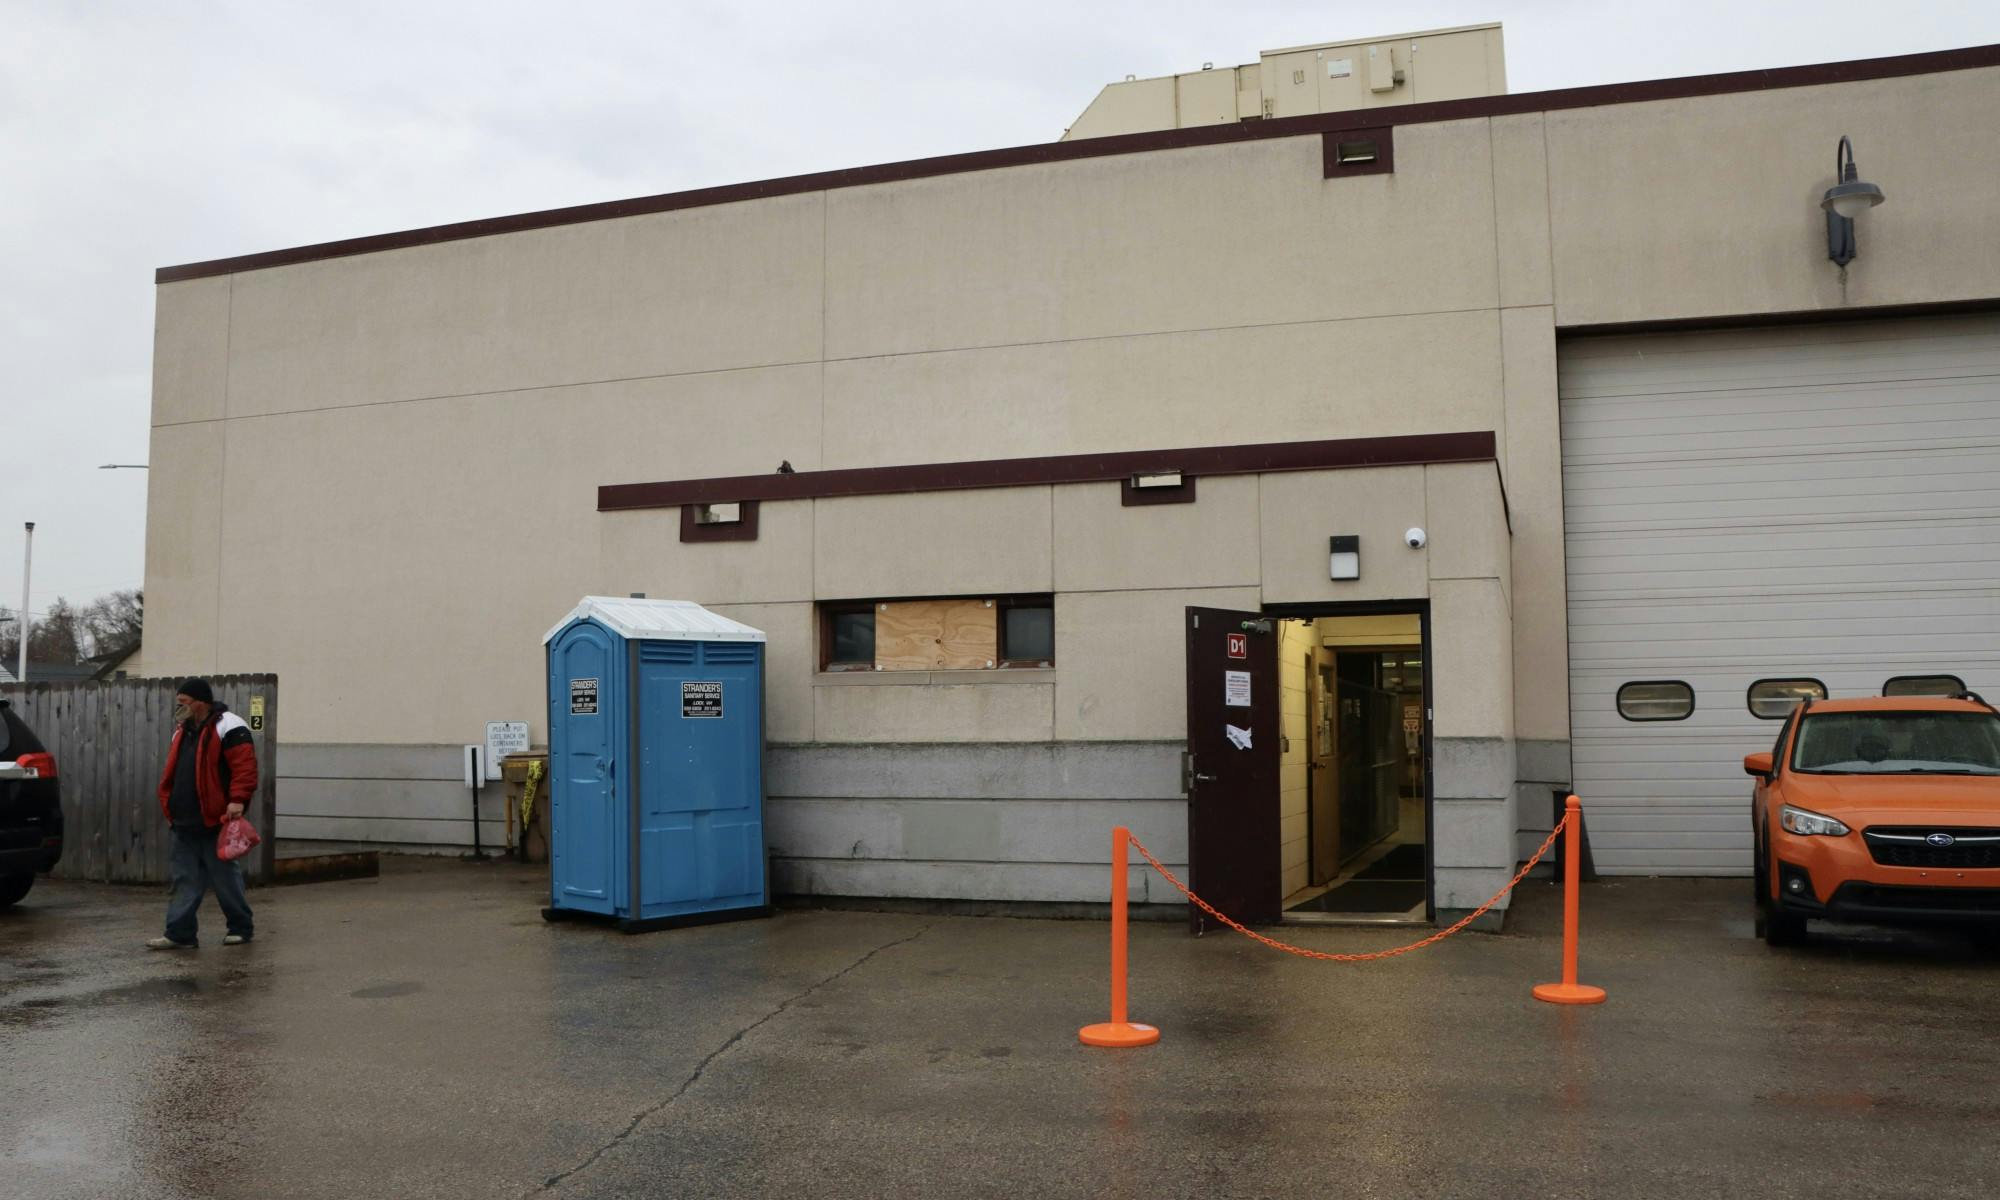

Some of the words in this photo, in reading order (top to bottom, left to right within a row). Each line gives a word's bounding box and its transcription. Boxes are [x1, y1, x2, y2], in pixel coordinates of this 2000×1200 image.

[1231, 639, 1244, 653] D1
[683, 684, 721, 692] STRANDER'S
[254, 717, 260, 727] 2
